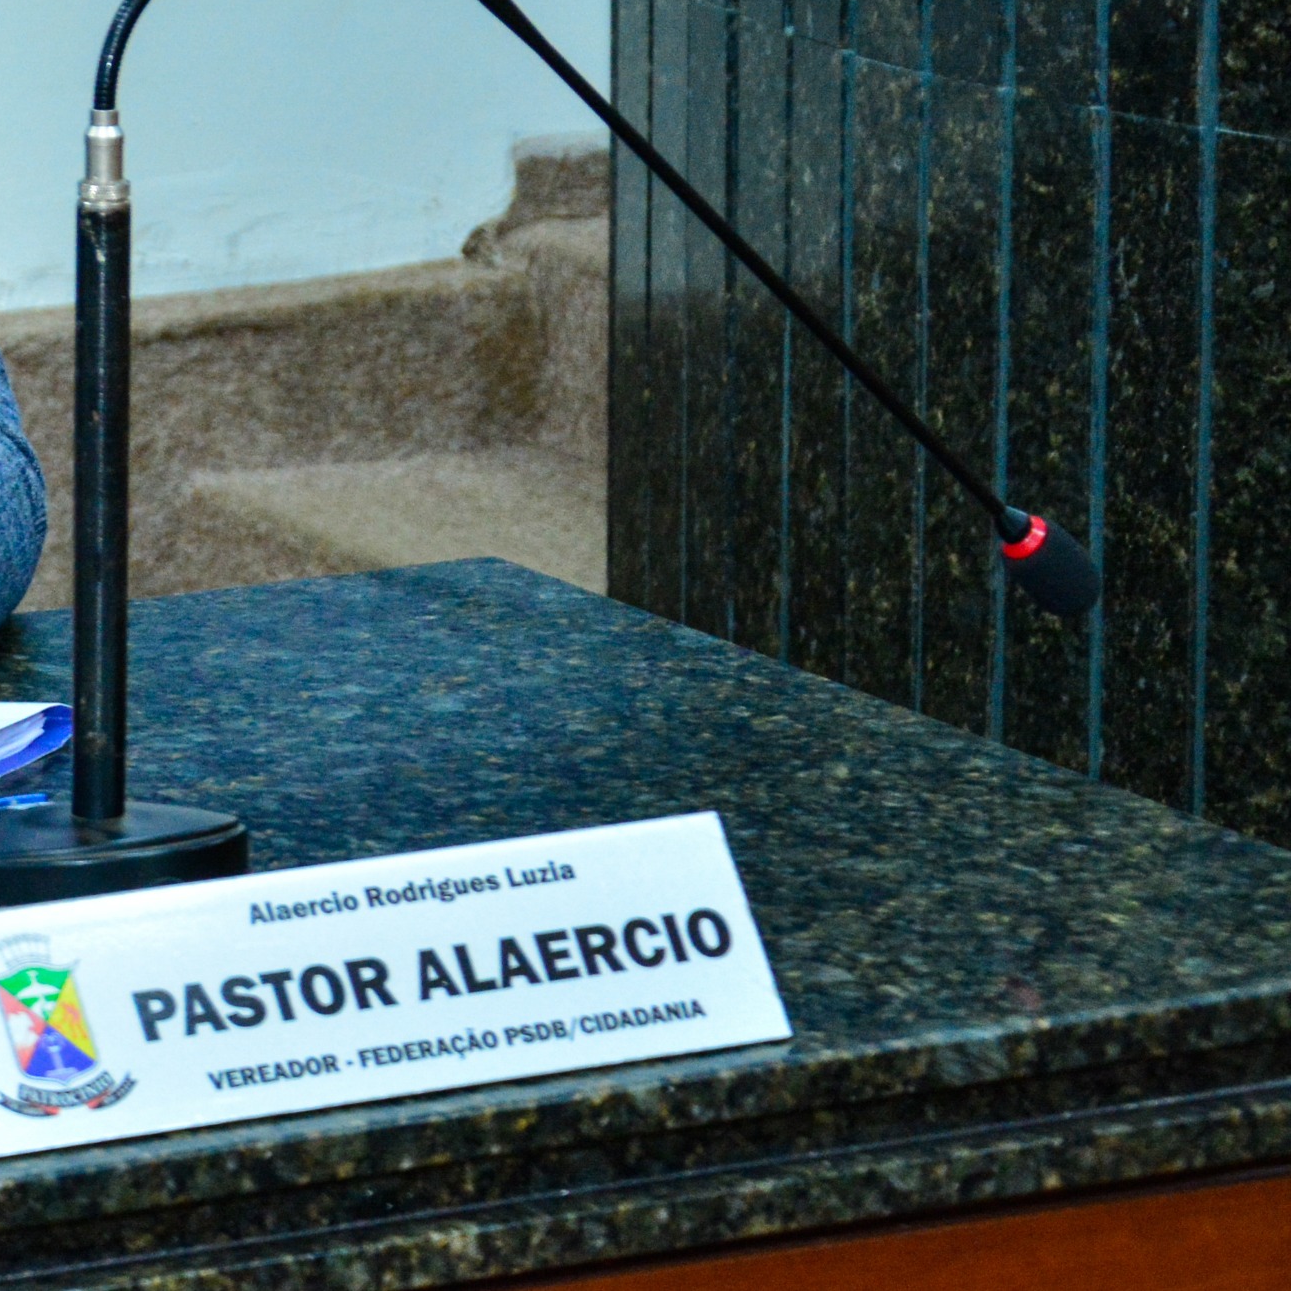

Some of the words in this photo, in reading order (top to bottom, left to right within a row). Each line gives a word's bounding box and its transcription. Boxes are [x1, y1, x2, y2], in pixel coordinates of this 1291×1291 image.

[250, 890, 359, 925] Alaercio
[364, 872, 500, 908] Rodrigues
[504, 860, 576, 888] Luzia
[131, 956, 397, 1042] PASTOR
[418, 907, 733, 1001] ALAERCIO
[207, 1054, 341, 1090] VEREADOR
[358, 1027, 499, 1069] FEDERAÇÃO
[504, 998, 708, 1046] PSDB/CIDADANIA
